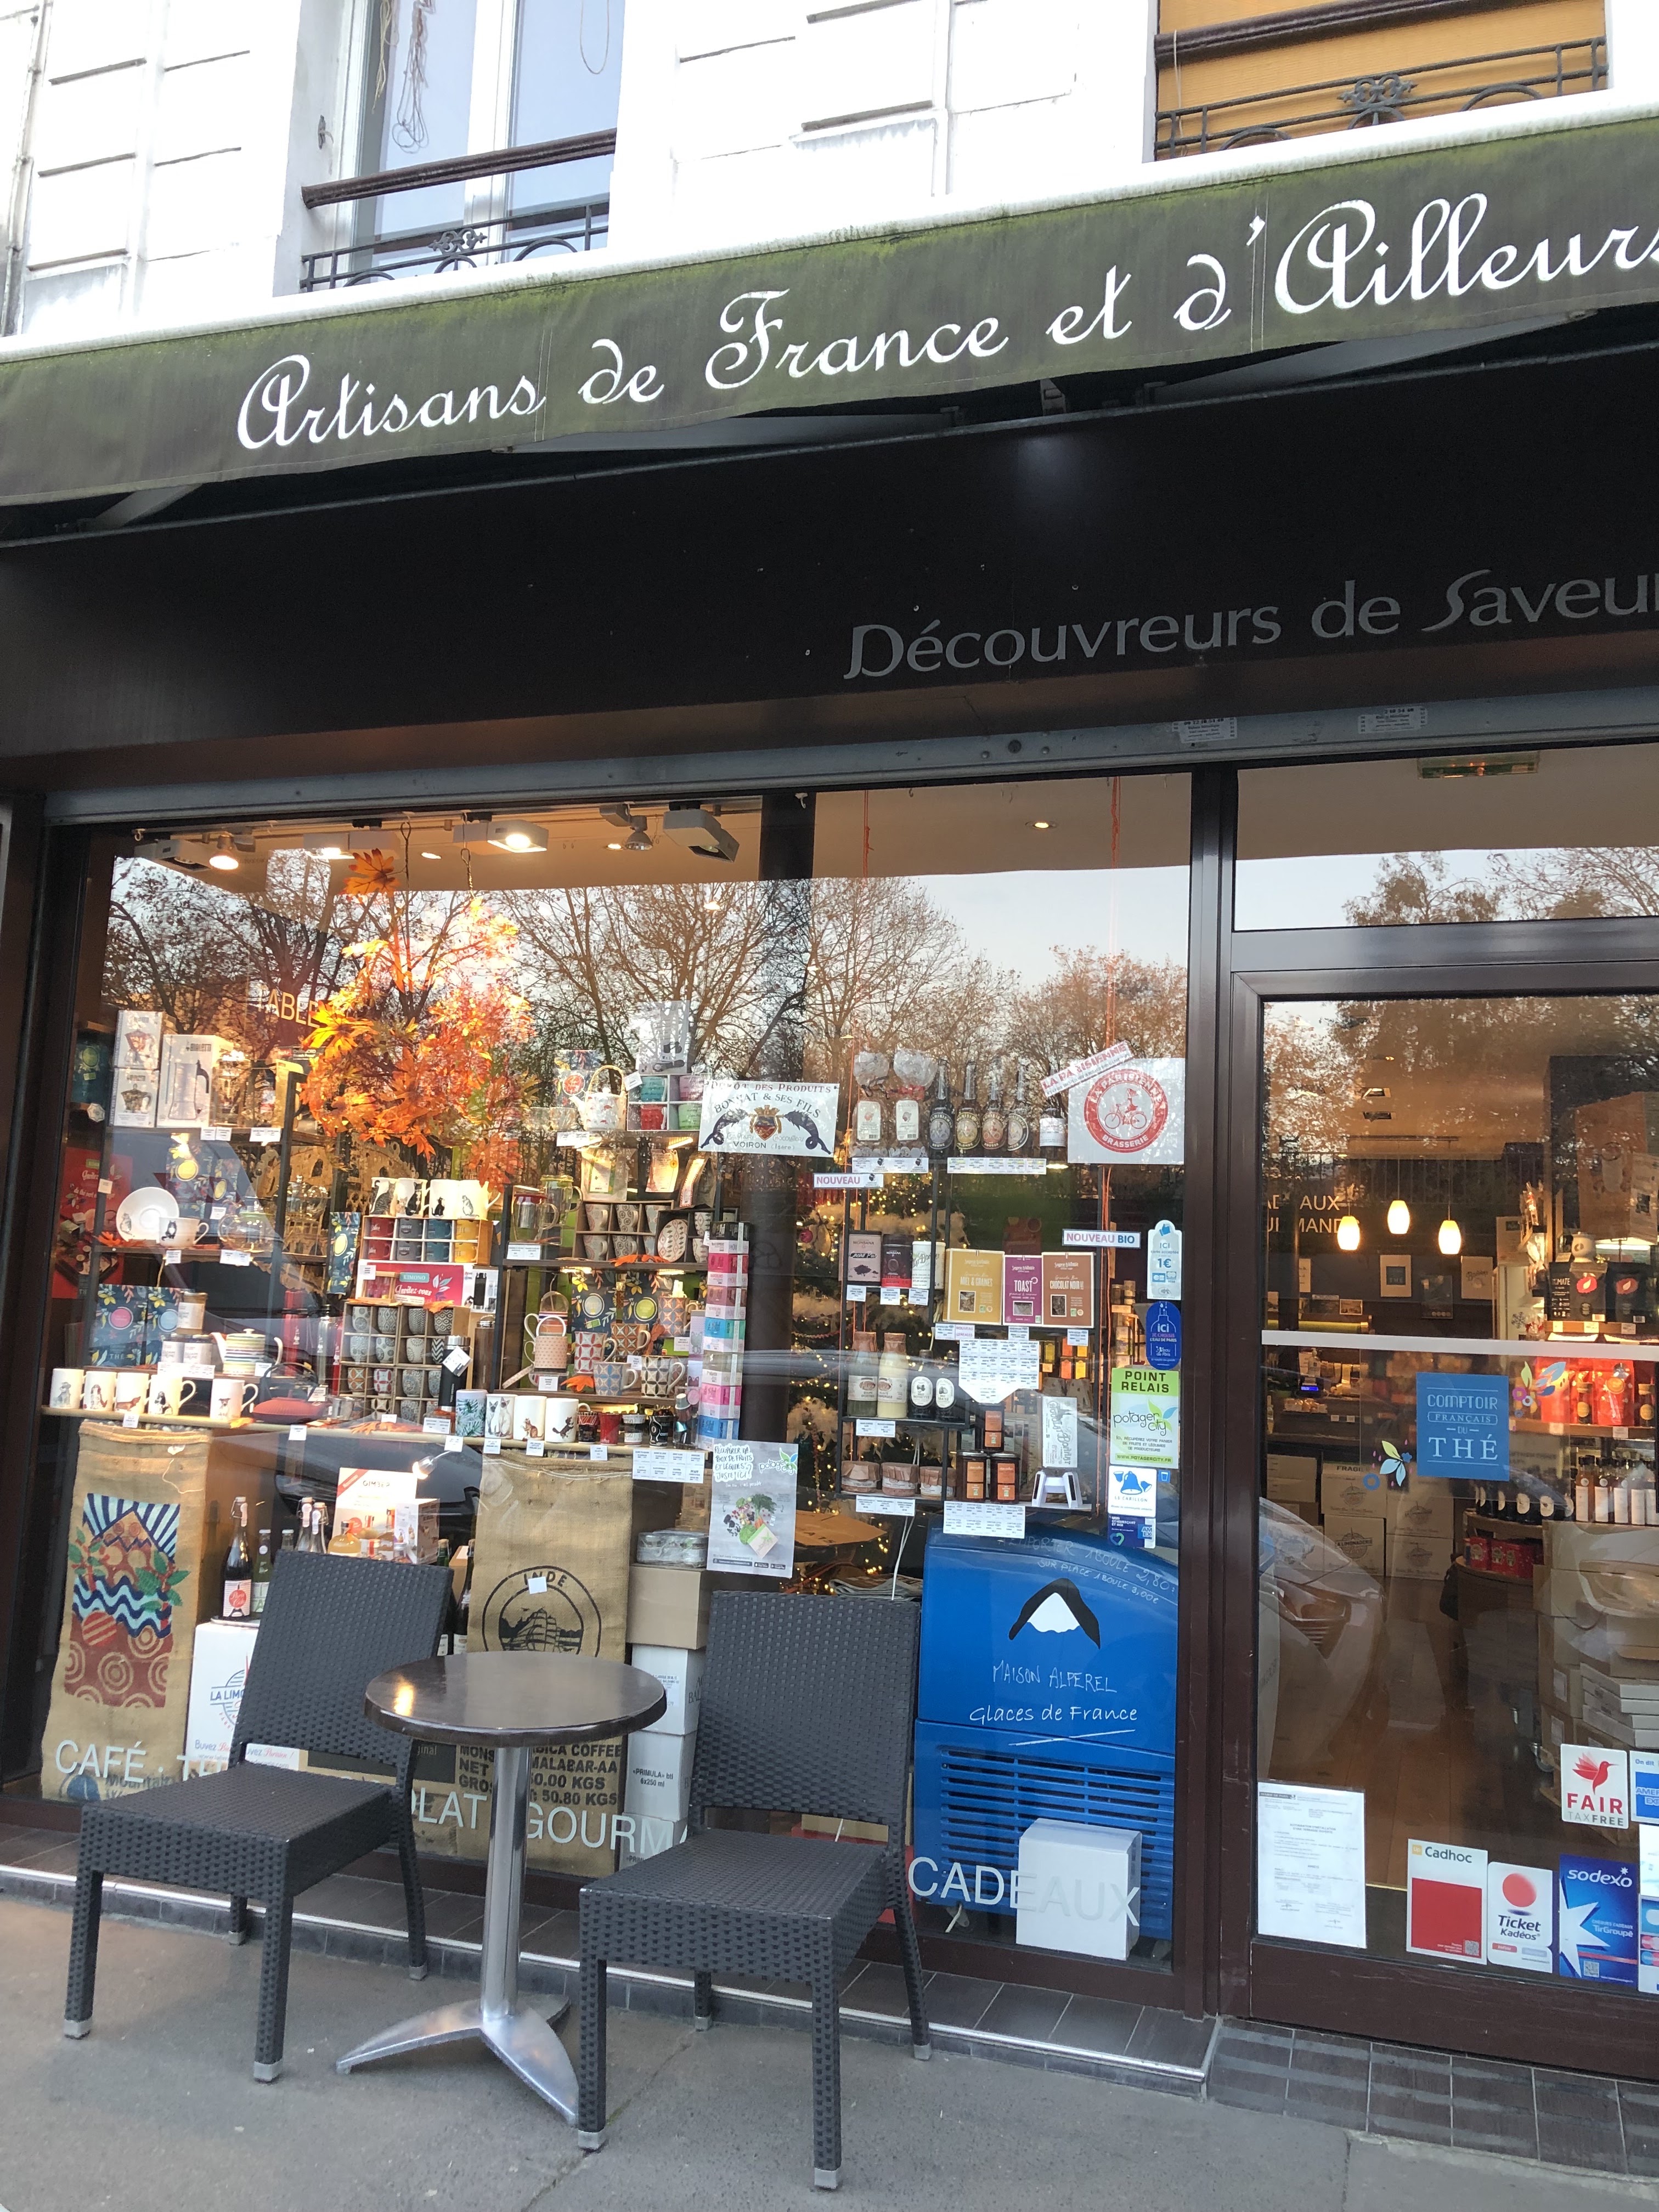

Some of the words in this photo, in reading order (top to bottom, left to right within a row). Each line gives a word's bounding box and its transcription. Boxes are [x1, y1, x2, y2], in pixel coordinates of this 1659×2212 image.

[237, 354, 546, 450] Artisans
[579, 338, 665, 405] de
[705, 289, 1009, 391] France
[1046, 264, 1133, 345] et
[844, 601, 1282, 680] Découvreurs
[1312, 579, 1401, 640] de
[778, 1083, 832, 1093] PRODUITS
[775, 1093, 793, 1104] SES
[795, 1098, 821, 1119] FILS
[733, 1141, 767, 1149] VOIRON
[1102, 1134, 1149, 1148] BRASSERIE
[816, 1175, 861, 1185] NOUVEAU
[1066, 1232, 1115, 1243] NOUVEAU
[1117, 1234, 1135, 1244] BIO
[1157, 1257, 1172, 1268] 1€
[960, 1276, 970, 1286] MIEL
[970, 1277, 975, 1286] &
[1014, 1280, 1033, 1293] TOAST
[1049, 1280, 1069, 1290] CHOCOLAT
[1070, 1281, 1080, 1290] NOIR
[1125, 1370, 1166, 1382] POINT
[1121, 1381, 1170, 1393] RELAIS
[1427, 1394, 1498, 1410] COMPTOIR
[1113, 1410, 1160, 1428] potager
[1435, 1413, 1491, 1423] FRANÇAIS
[1148, 1419, 1167, 1436] city
[1457, 1426, 1468, 1435] DU
[1428, 1434, 1498, 1460] THÉ
[1037, 1559, 1057, 1568] SUR
[1060, 1562, 1092, 1578] PLACE
[523, 1571, 568, 1588] INDE
[993, 1660, 1041, 1684] MAISON
[1049, 1667, 1118, 1694] ALPEREL
[210, 1690, 222, 1701] LA
[969, 1706, 1035, 1726] Glaces
[1041, 1705, 1063, 1722] de
[1070, 1706, 1138, 1722] France
[195, 1739, 217, 1751] Buvez
[571, 1743, 623, 1758] COFFEE
[55, 1740, 146, 1784] CAFÉ
[459, 1757, 489, 1776] NET
[571, 1776, 606, 1791] KGS
[640, 1777, 657, 1786] 6x250
[541, 1791, 580, 1805] 50.80
[585, 1792, 617, 1806] KGS
[1567, 1792, 1623, 1815] FAIR
[1568, 1811, 1624, 1827] TAXFREE
[1425, 1846, 1472, 1864] Cadhoc
[1567, 1867, 1633, 1888] sodexo
[908, 1856, 1140, 1927] CADEAUX
[1498, 1914, 1542, 1932] Ticket
